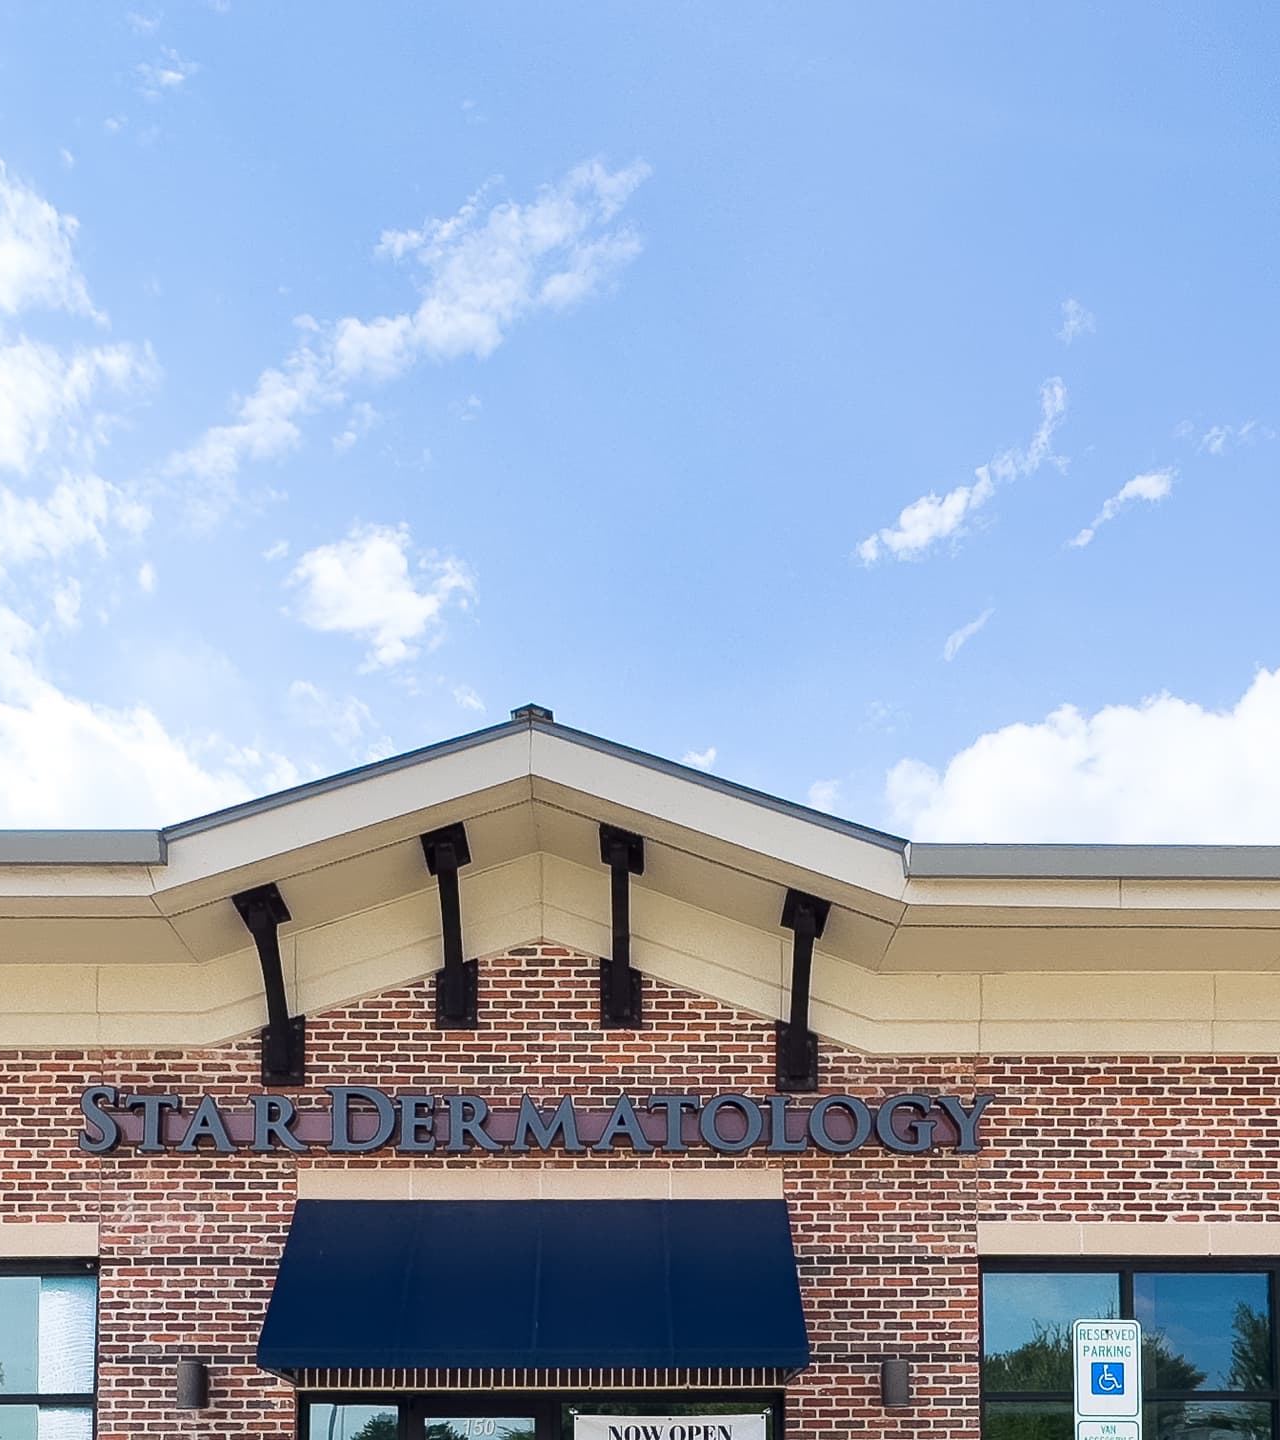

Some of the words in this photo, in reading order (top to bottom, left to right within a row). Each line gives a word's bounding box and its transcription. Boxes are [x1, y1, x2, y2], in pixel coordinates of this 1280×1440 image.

[79, 1086, 310, 1154] STAR
[324, 1085, 995, 1154] DERMATOLOGY
[1079, 1328, 1135, 1341] RESERVED
[1083, 1345, 1132, 1358] PARKING
[464, 1417, 496, 1435] 150
[1100, 1425, 1116, 1434] VAN
